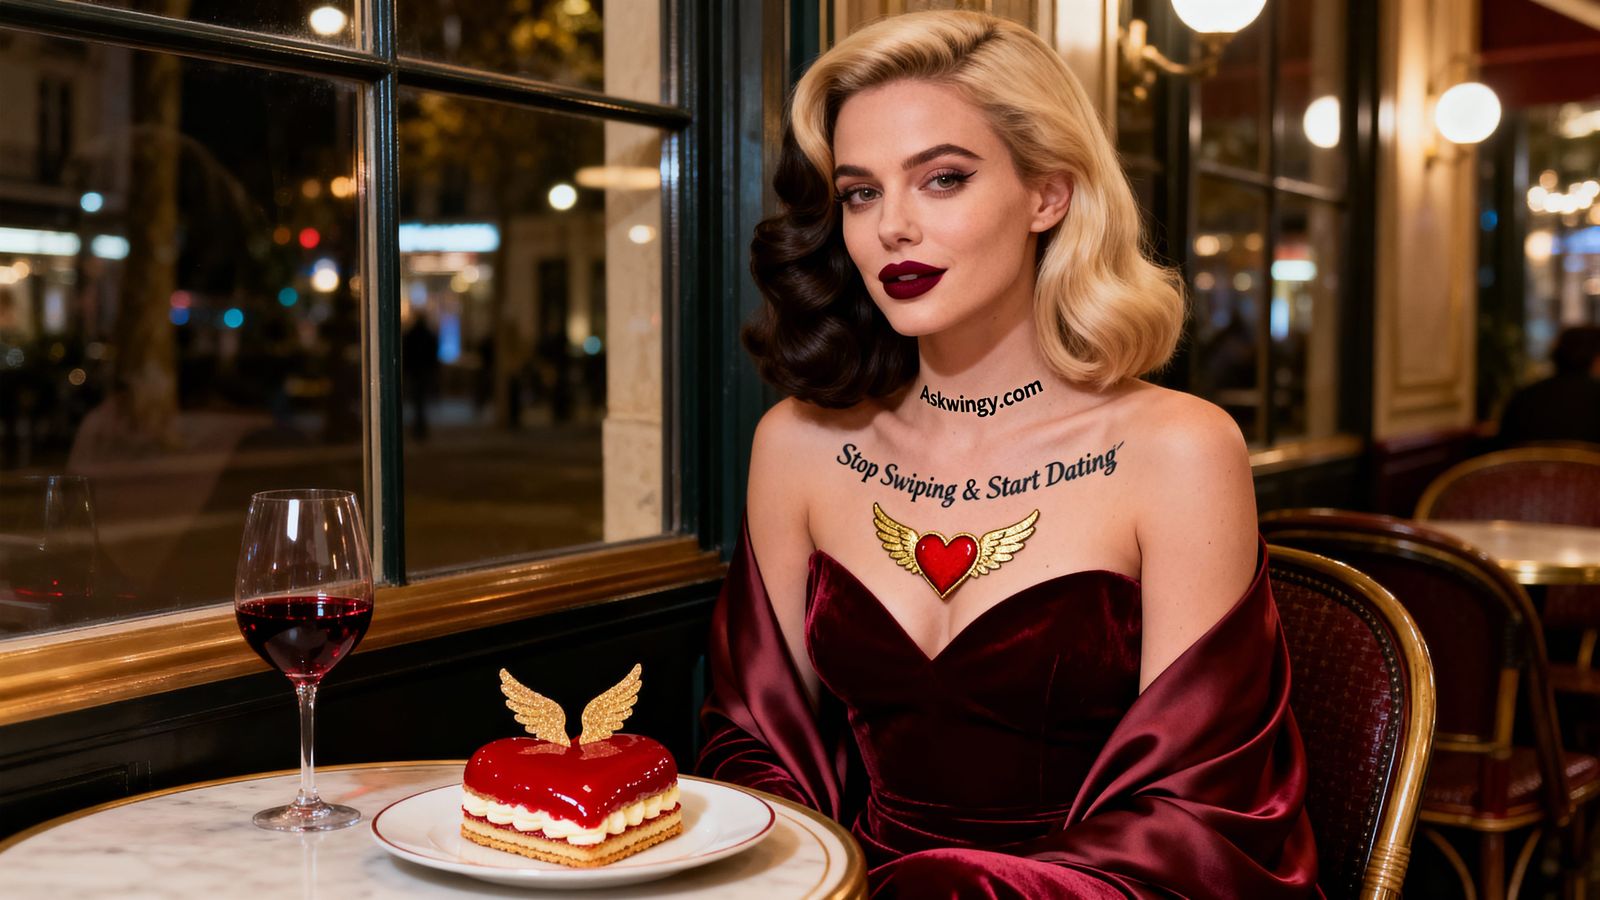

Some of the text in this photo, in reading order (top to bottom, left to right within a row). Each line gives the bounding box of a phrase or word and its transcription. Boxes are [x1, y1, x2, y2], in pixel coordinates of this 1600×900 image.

[919, 380, 1043, 417] Askwingy.com
[836, 443, 1120, 508] Stop Swiping & Start Dating
